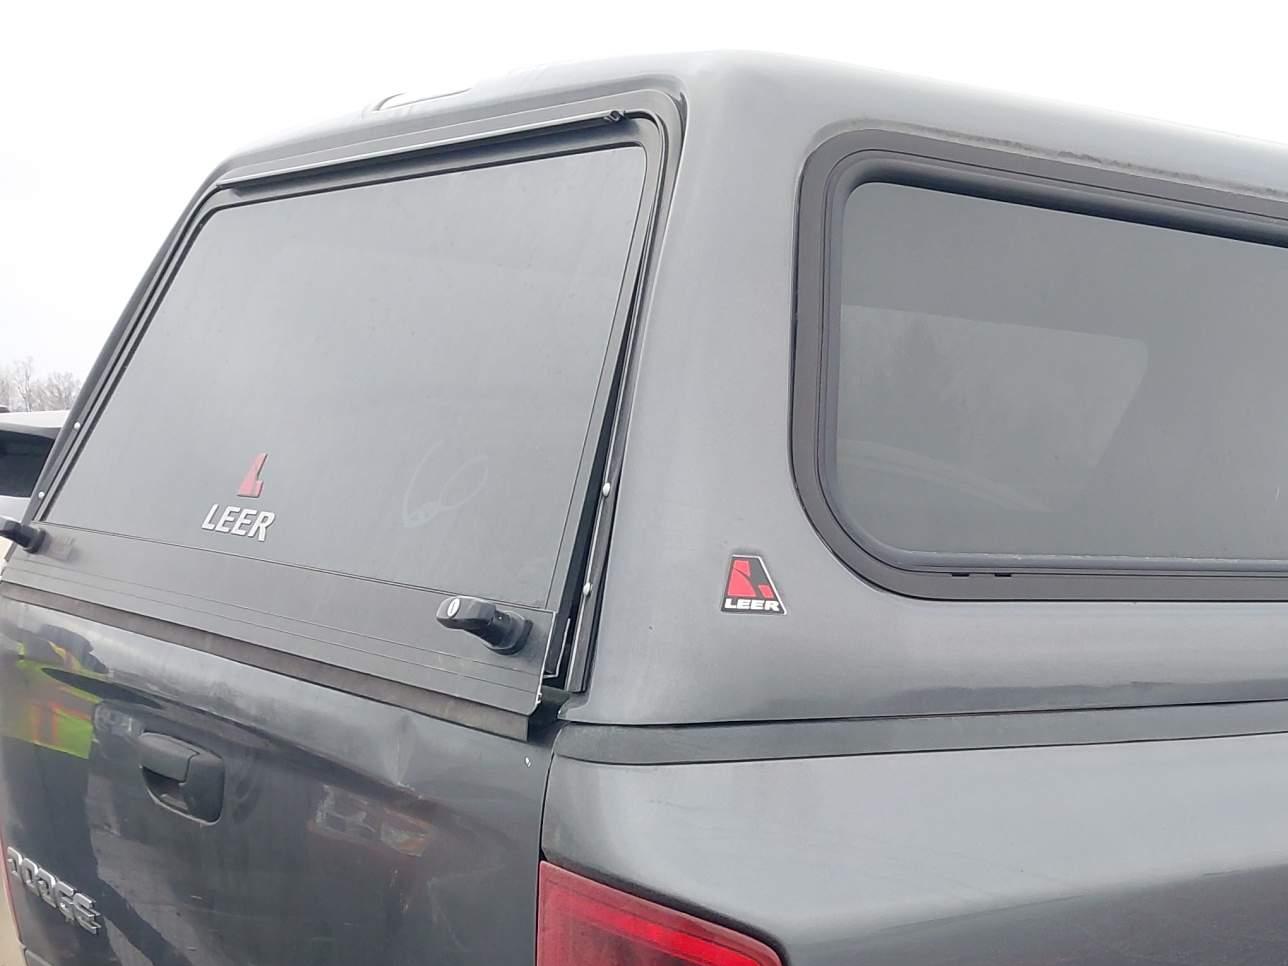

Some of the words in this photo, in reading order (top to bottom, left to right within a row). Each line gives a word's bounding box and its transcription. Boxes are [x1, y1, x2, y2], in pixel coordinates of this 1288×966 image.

[201, 503, 275, 542] LEER
[724, 598, 780, 611] LEER
[7, 846, 101, 935] DODGE
